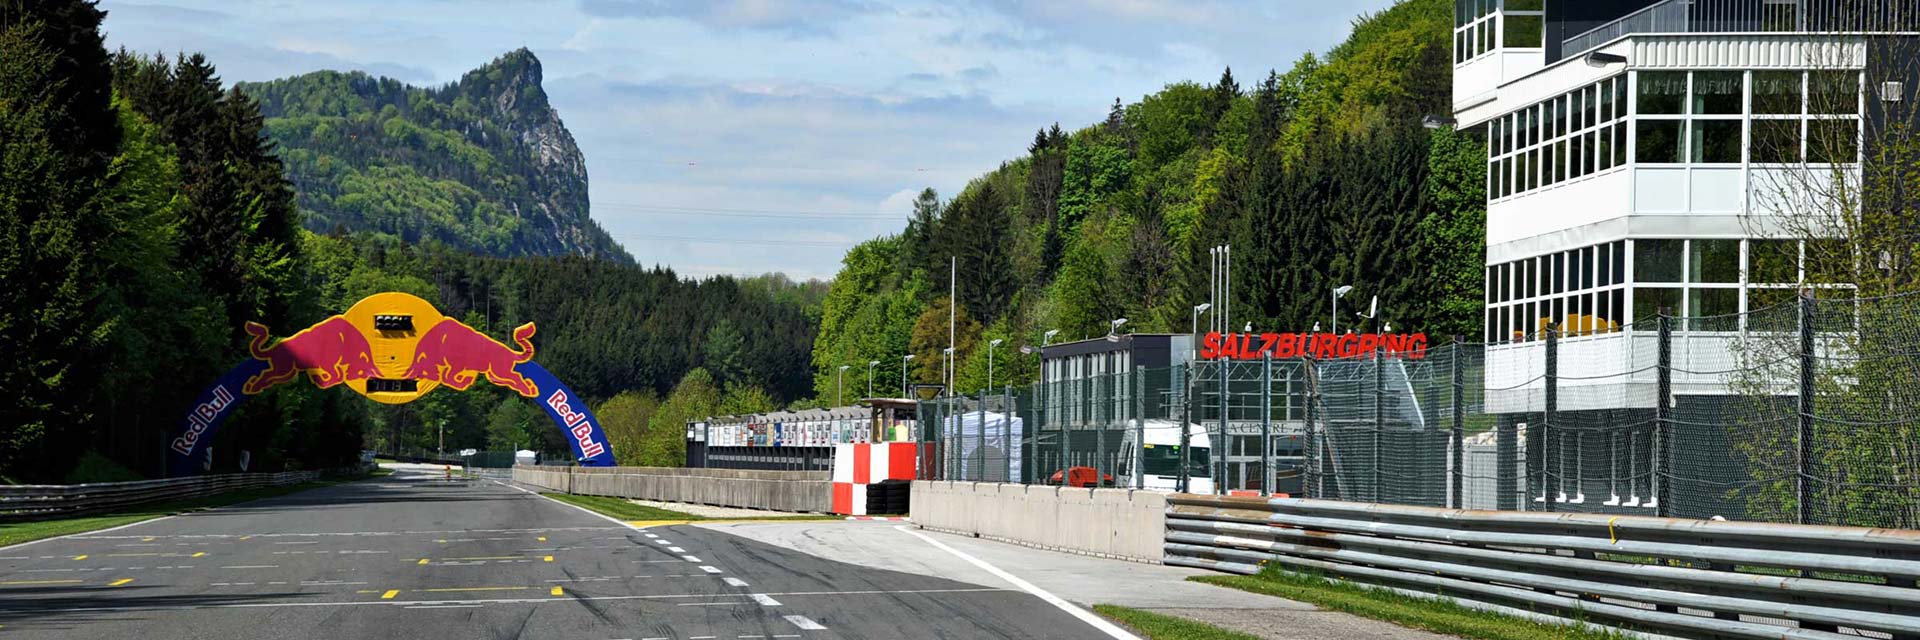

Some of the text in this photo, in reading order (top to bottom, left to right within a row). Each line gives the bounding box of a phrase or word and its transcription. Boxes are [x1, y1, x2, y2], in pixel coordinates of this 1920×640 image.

[1201, 331, 1427, 360] SALZBURGRING
[171, 385, 235, 456] Red Bull
[547, 389, 605, 458] Red Bull
[1240, 422, 1286, 434] CENRE
